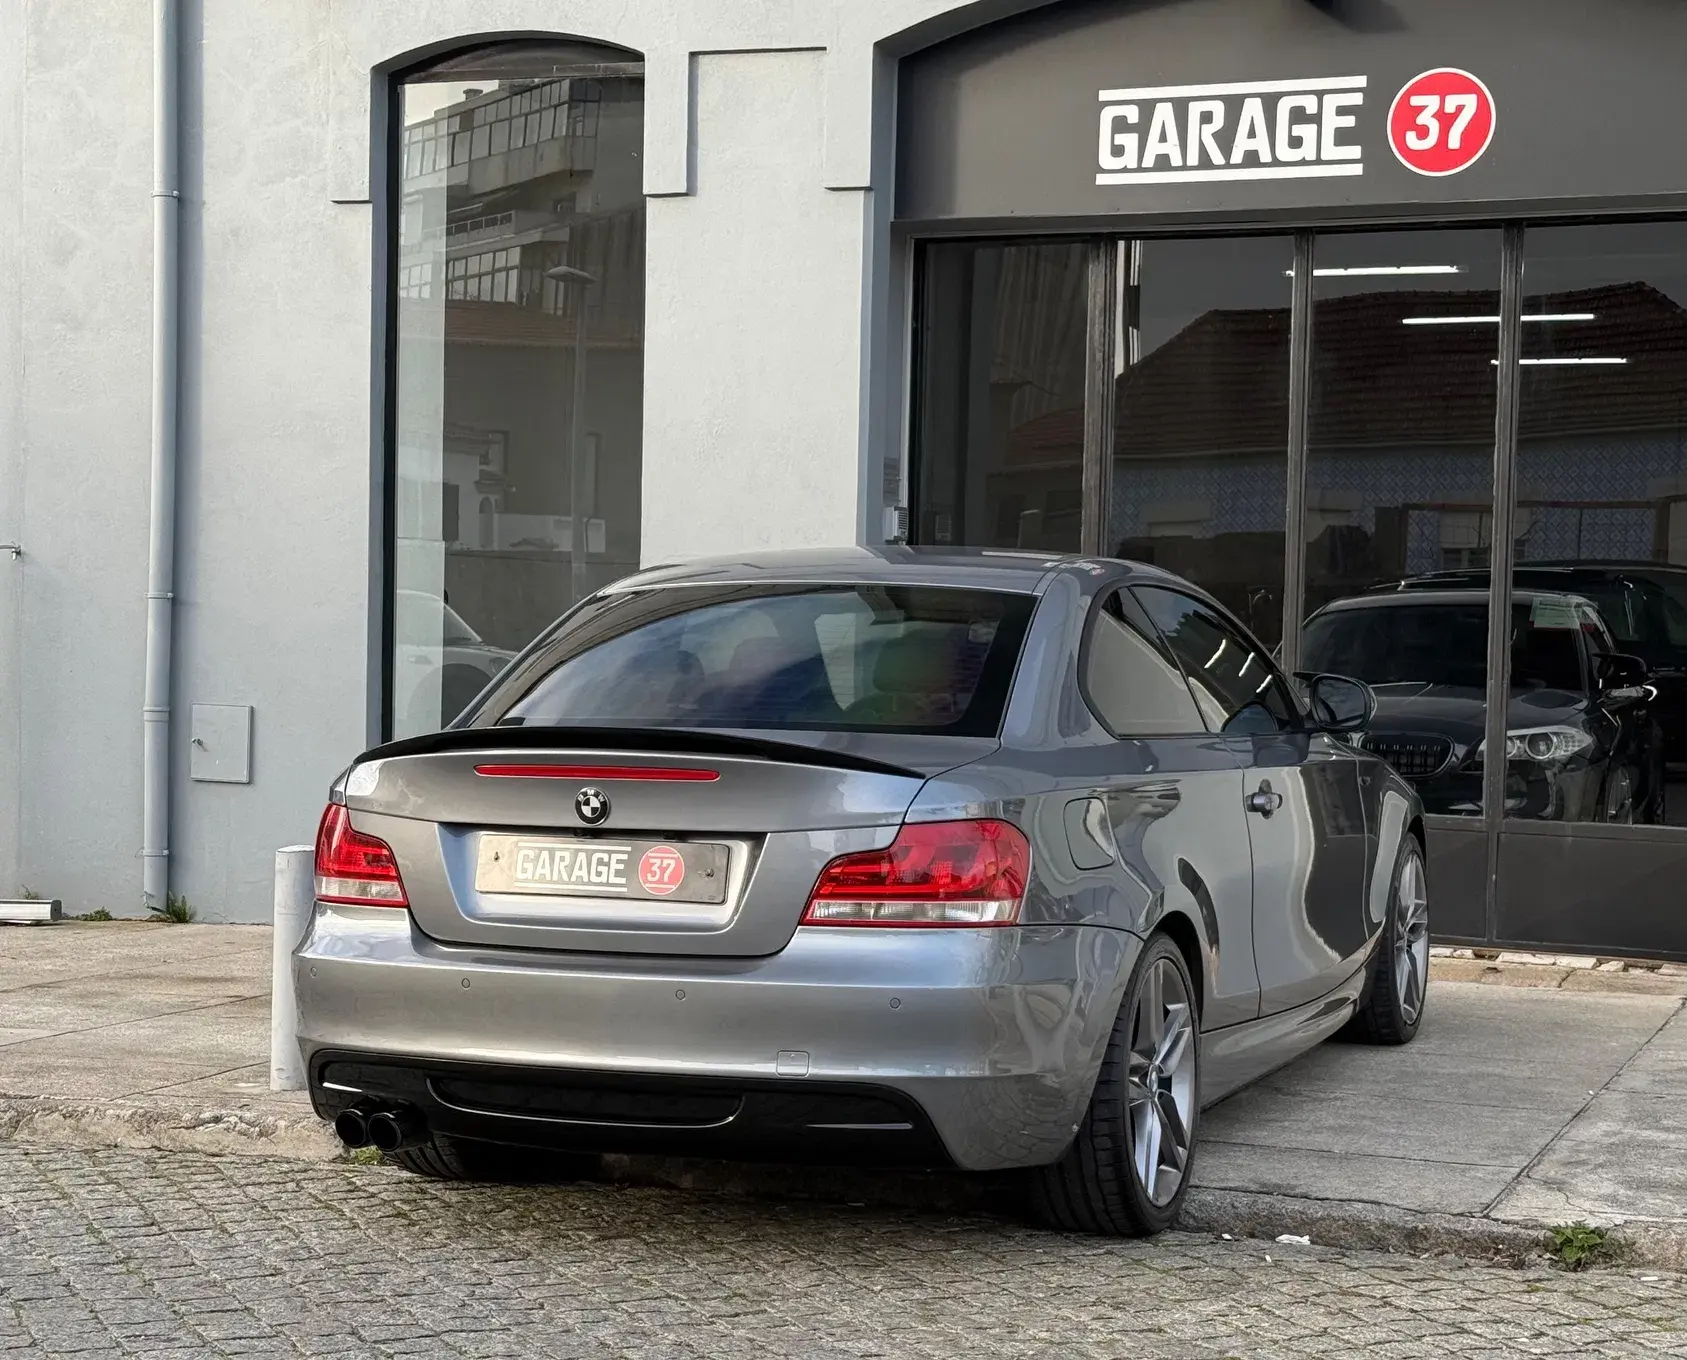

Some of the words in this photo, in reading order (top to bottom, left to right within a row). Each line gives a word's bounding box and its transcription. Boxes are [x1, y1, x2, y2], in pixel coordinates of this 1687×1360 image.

[1098, 92, 1364, 170] GARAGE
[1404, 93, 1478, 151] 37
[577, 789, 605, 802] BMW
[515, 849, 629, 884] GARAGE
[646, 858, 676, 883] 37
